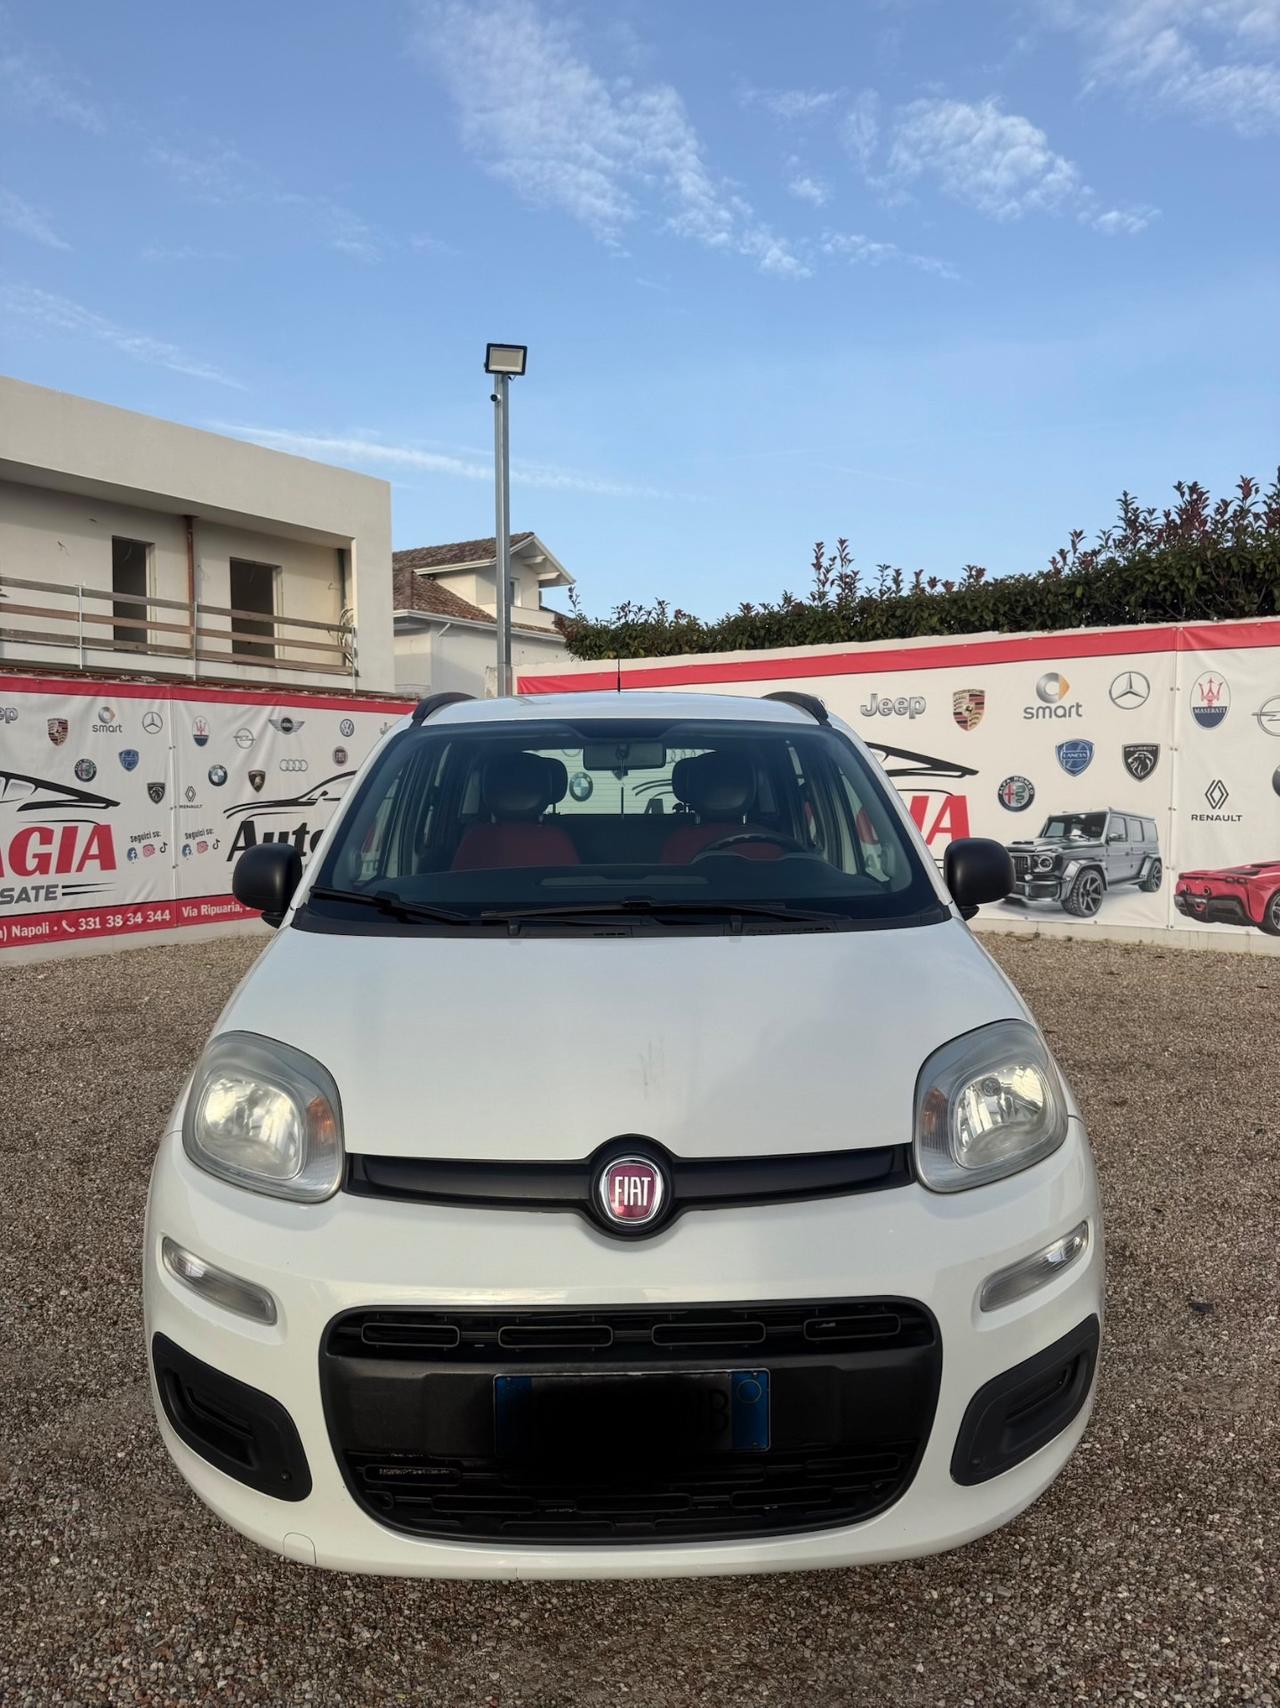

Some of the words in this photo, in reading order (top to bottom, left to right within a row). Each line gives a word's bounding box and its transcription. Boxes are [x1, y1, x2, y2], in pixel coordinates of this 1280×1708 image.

[860, 693, 927, 720] Jeep
[1023, 702, 1083, 720] smart
[92, 724, 123, 734] smart
[1191, 813, 1243, 823] RENAULT
[182, 906, 198, 917] Via
[201, 902, 243, 916] Ripuaria,
[12, 922, 49, 938] Napoli
[78, 917, 101, 931] 331
[106, 914, 123, 928] 38
[126, 912, 143, 925] 34
[146, 909, 171, 923] 344
[614, 1176, 652, 1207] FIAT
